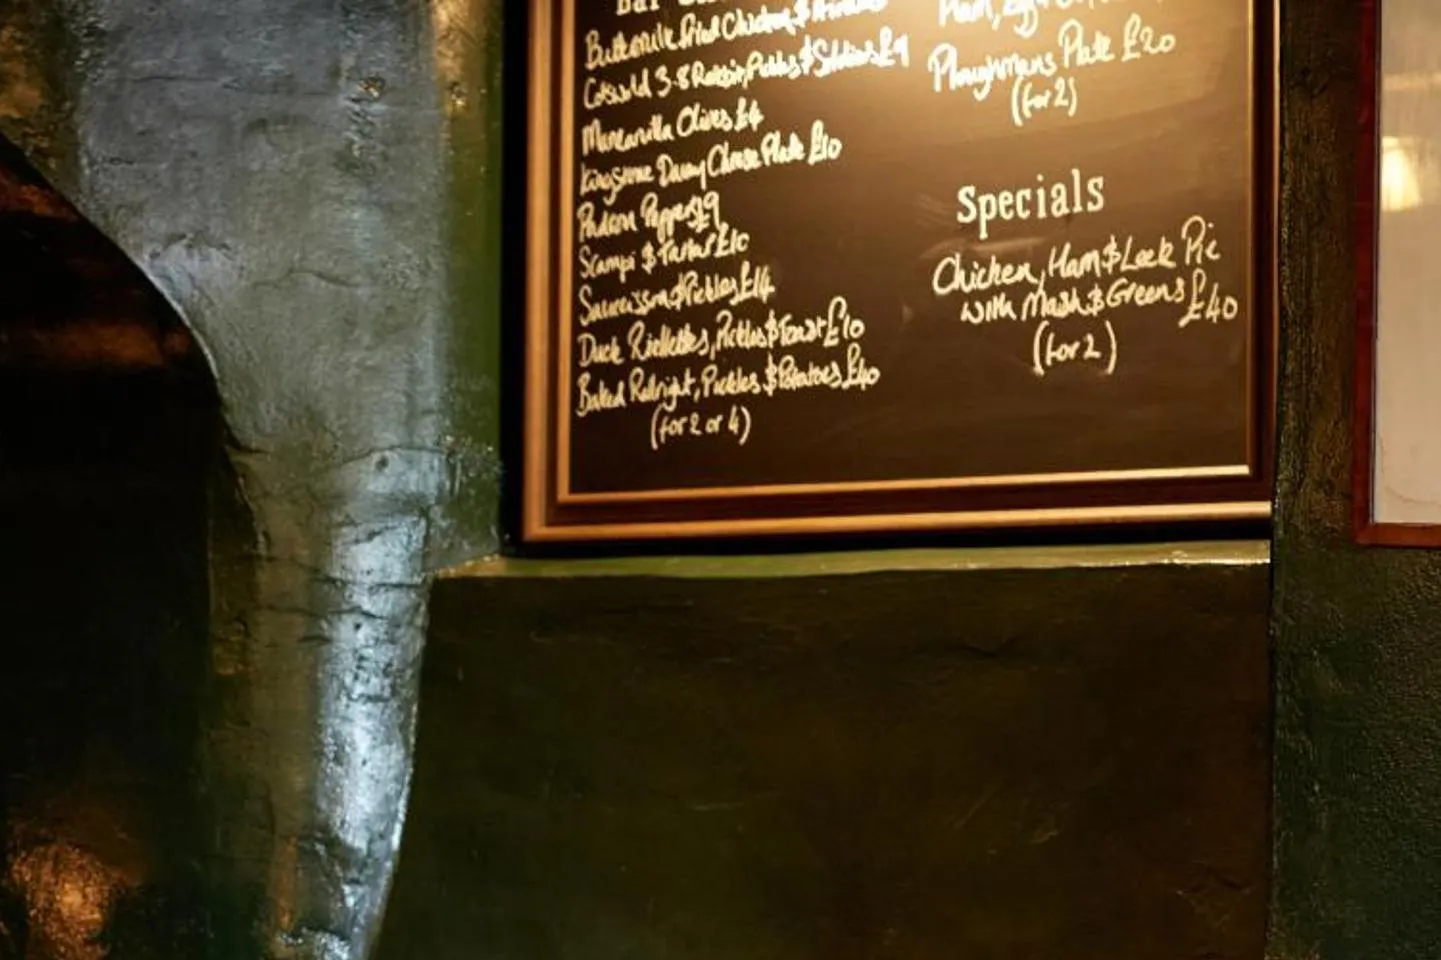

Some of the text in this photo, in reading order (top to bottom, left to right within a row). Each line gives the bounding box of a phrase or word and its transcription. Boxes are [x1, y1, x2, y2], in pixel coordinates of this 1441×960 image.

[1059, 20, 1115, 69] Plate
[1122, 15, 1176, 62] £20
[678, 104, 733, 138] Olives
[735, 98, 764, 132] £4
[1013, 78, 1078, 127] (for 2)
[762, 133, 805, 167] Plate
[808, 120, 843, 165] £10
[957, 170, 1105, 240] Specials
[579, 246, 636, 283] Scampi
[714, 223, 750, 258] £10
[1049, 244, 1102, 280] Ham
[1122, 237, 1177, 272] Leek
[1182, 217, 1221, 266] Pie
[961, 295, 1016, 325] with
[1022, 291, 1088, 322] Mash
[1107, 279, 1185, 307] Greens
[1178, 269, 1239, 328] £40
[578, 335, 624, 367] Duck
[779, 313, 827, 346] Toast
[824, 298, 866, 348] £10
[1034, 322, 1118, 376] (for 2)
[576, 373, 626, 417] Baked
[701, 366, 761, 399] Pickles
[778, 357, 841, 391] Potatoes
[841, 344, 882, 391] £40
[652, 407, 751, 450] (for 2 or 4)
